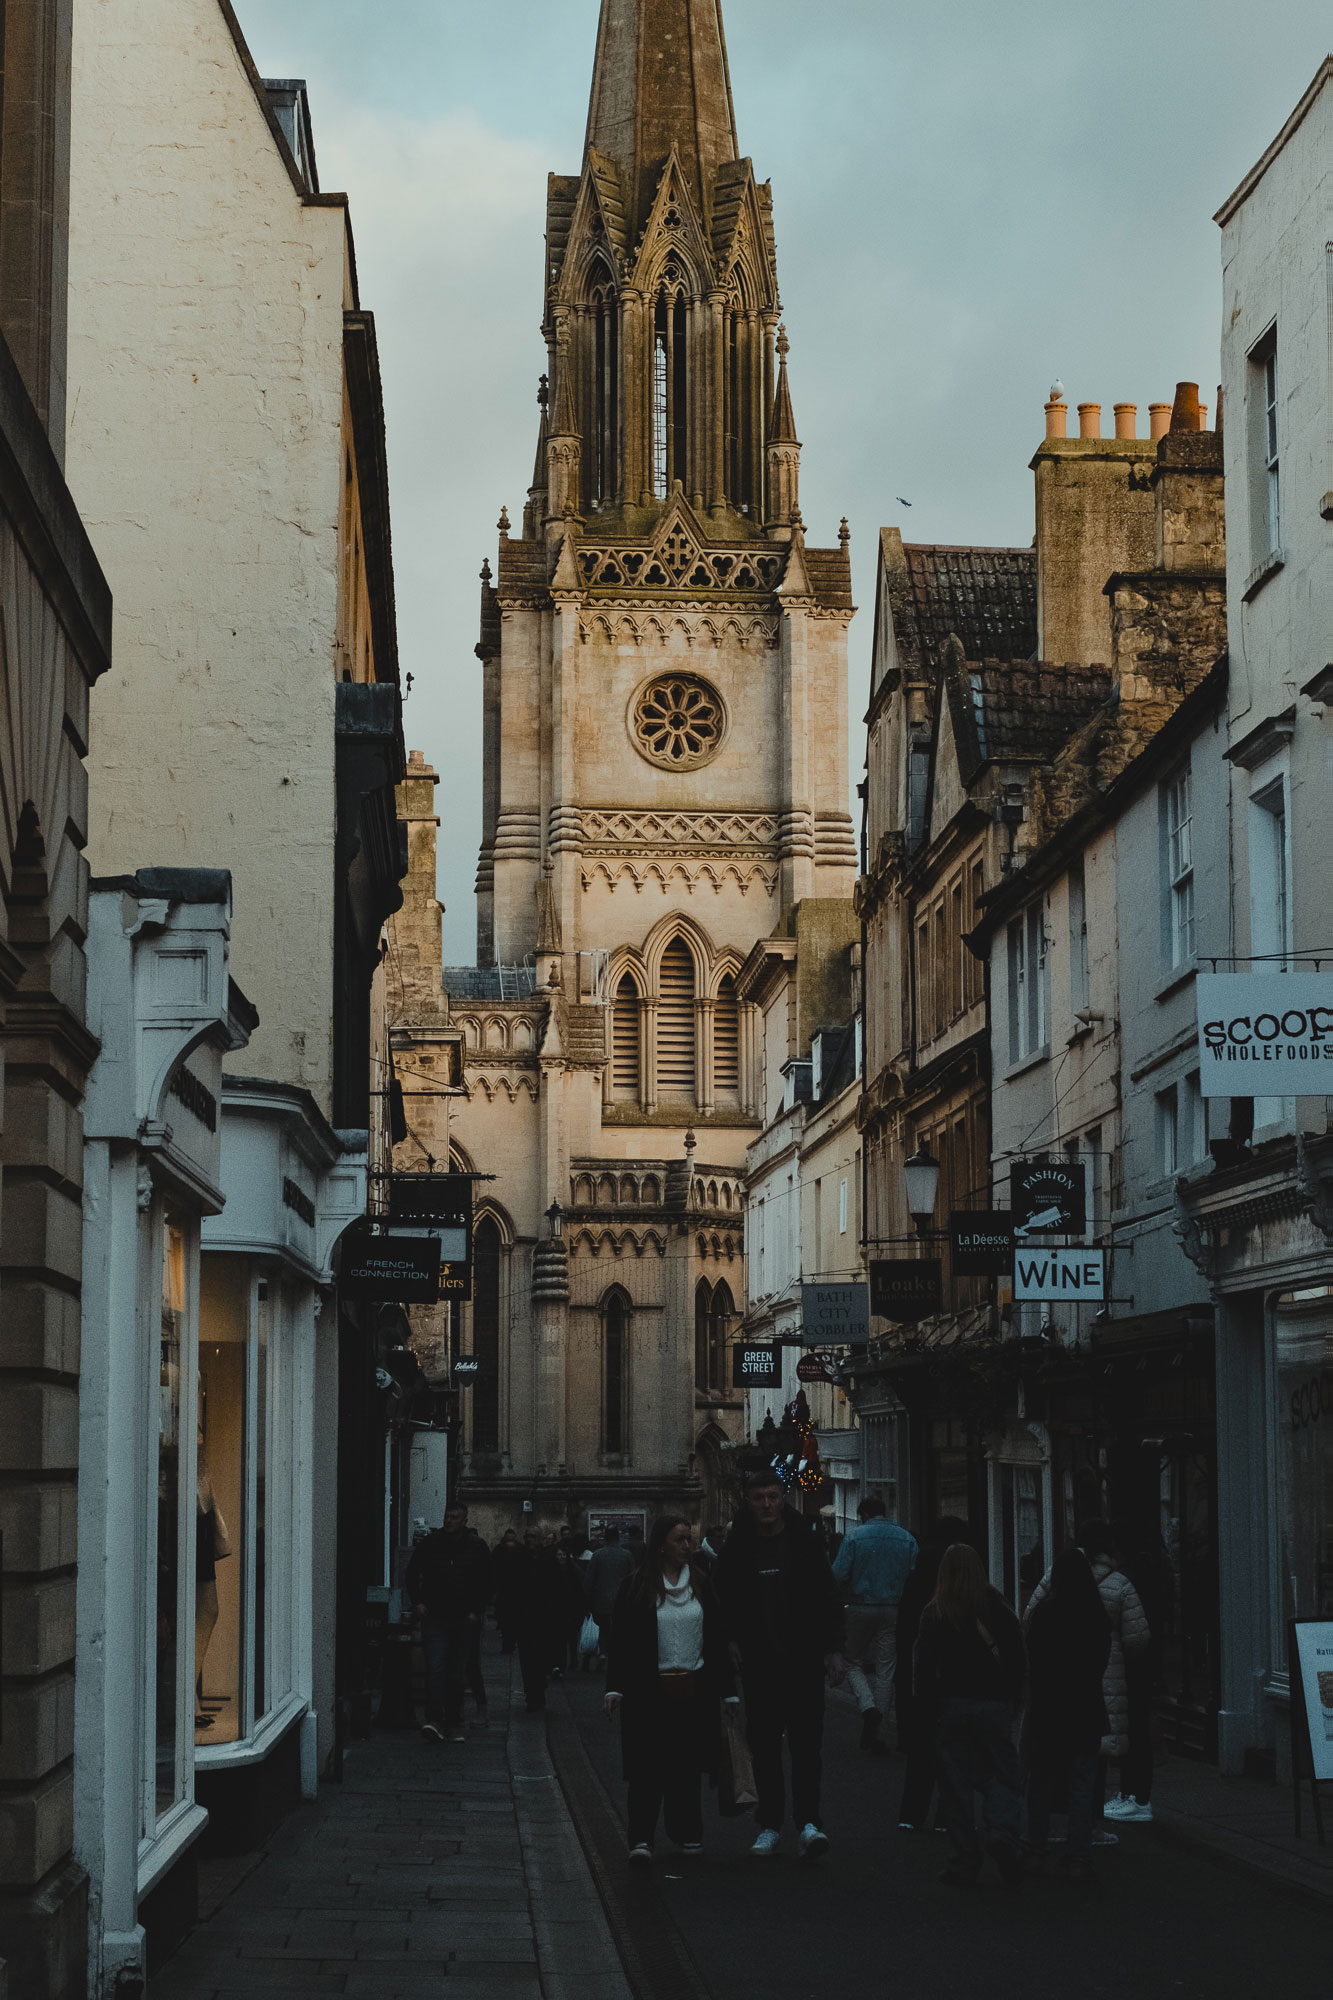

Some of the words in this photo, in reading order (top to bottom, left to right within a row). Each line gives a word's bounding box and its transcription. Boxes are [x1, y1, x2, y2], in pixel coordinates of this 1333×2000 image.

[1212, 1044, 1333, 1061] WHOLEFOODS
[1022, 1170, 1076, 1190] FASHION
[958, 1233, 970, 1245] La
[972, 1233, 1010, 1245] Déesse
[366, 1259, 414, 1269] FRENCH
[350, 1269, 429, 1280] CONNECTION
[876, 1275, 936, 1292] Loake
[817, 1291, 853, 1303] BATH
[819, 1307, 852, 1319] CITY
[805, 1323, 868, 1336] COBBLER
[744, 1351, 773, 1362] GREEN
[741, 1362, 775, 1373] STREET
